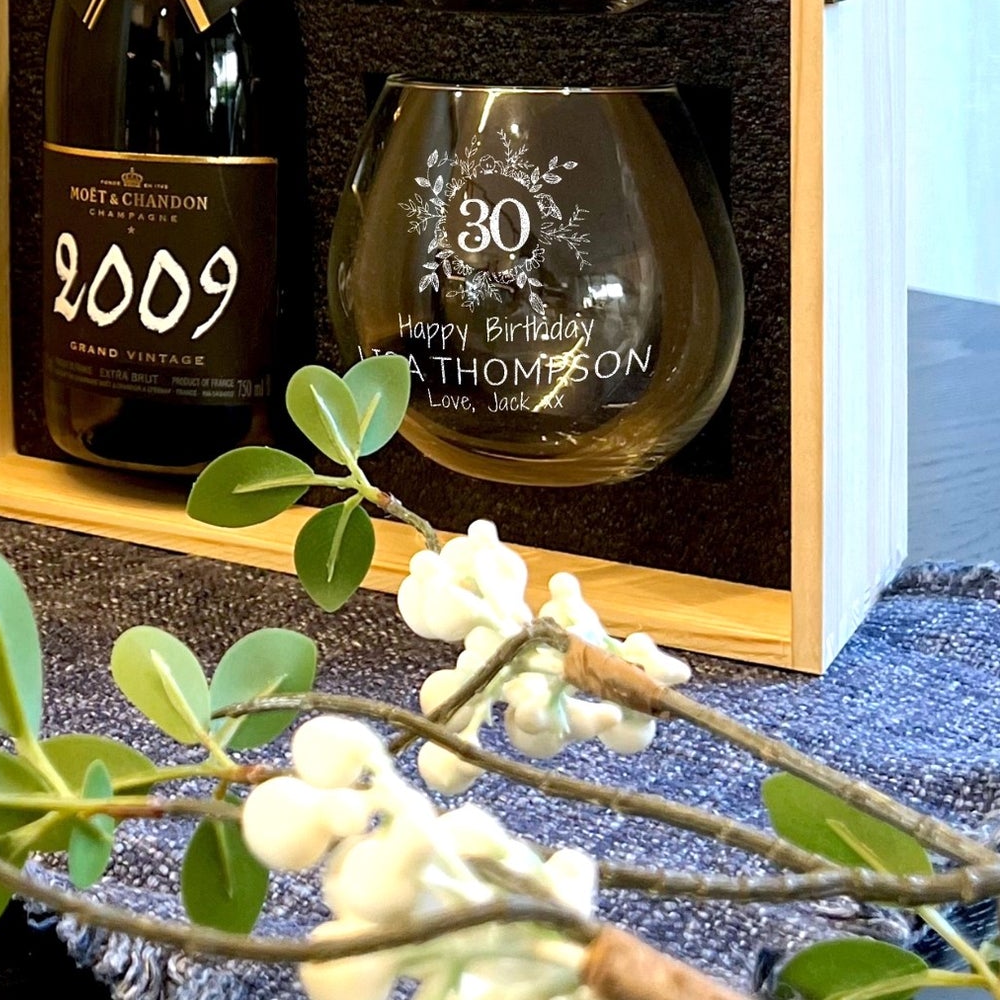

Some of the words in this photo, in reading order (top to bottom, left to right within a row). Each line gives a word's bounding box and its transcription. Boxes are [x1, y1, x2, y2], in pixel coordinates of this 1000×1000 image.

[70, 186, 107, 204] MOËT
[109, 193, 119, 206] &
[121, 192, 208, 211] CHANDON
[89, 208, 179, 223] CHAMPAGNE
[457, 198, 531, 252] 30
[53, 232, 238, 340] 2009
[398, 313, 469, 350] Happy
[486, 316, 594, 346] Birthday
[70, 341, 118, 358] GRAND
[126, 350, 205, 366] VINTAGE
[432, 345, 651, 387] THOMPSON
[131, 372, 159, 385] BRUT
[428, 389, 475, 413] Love,
[488, 391, 530, 411] Jack
